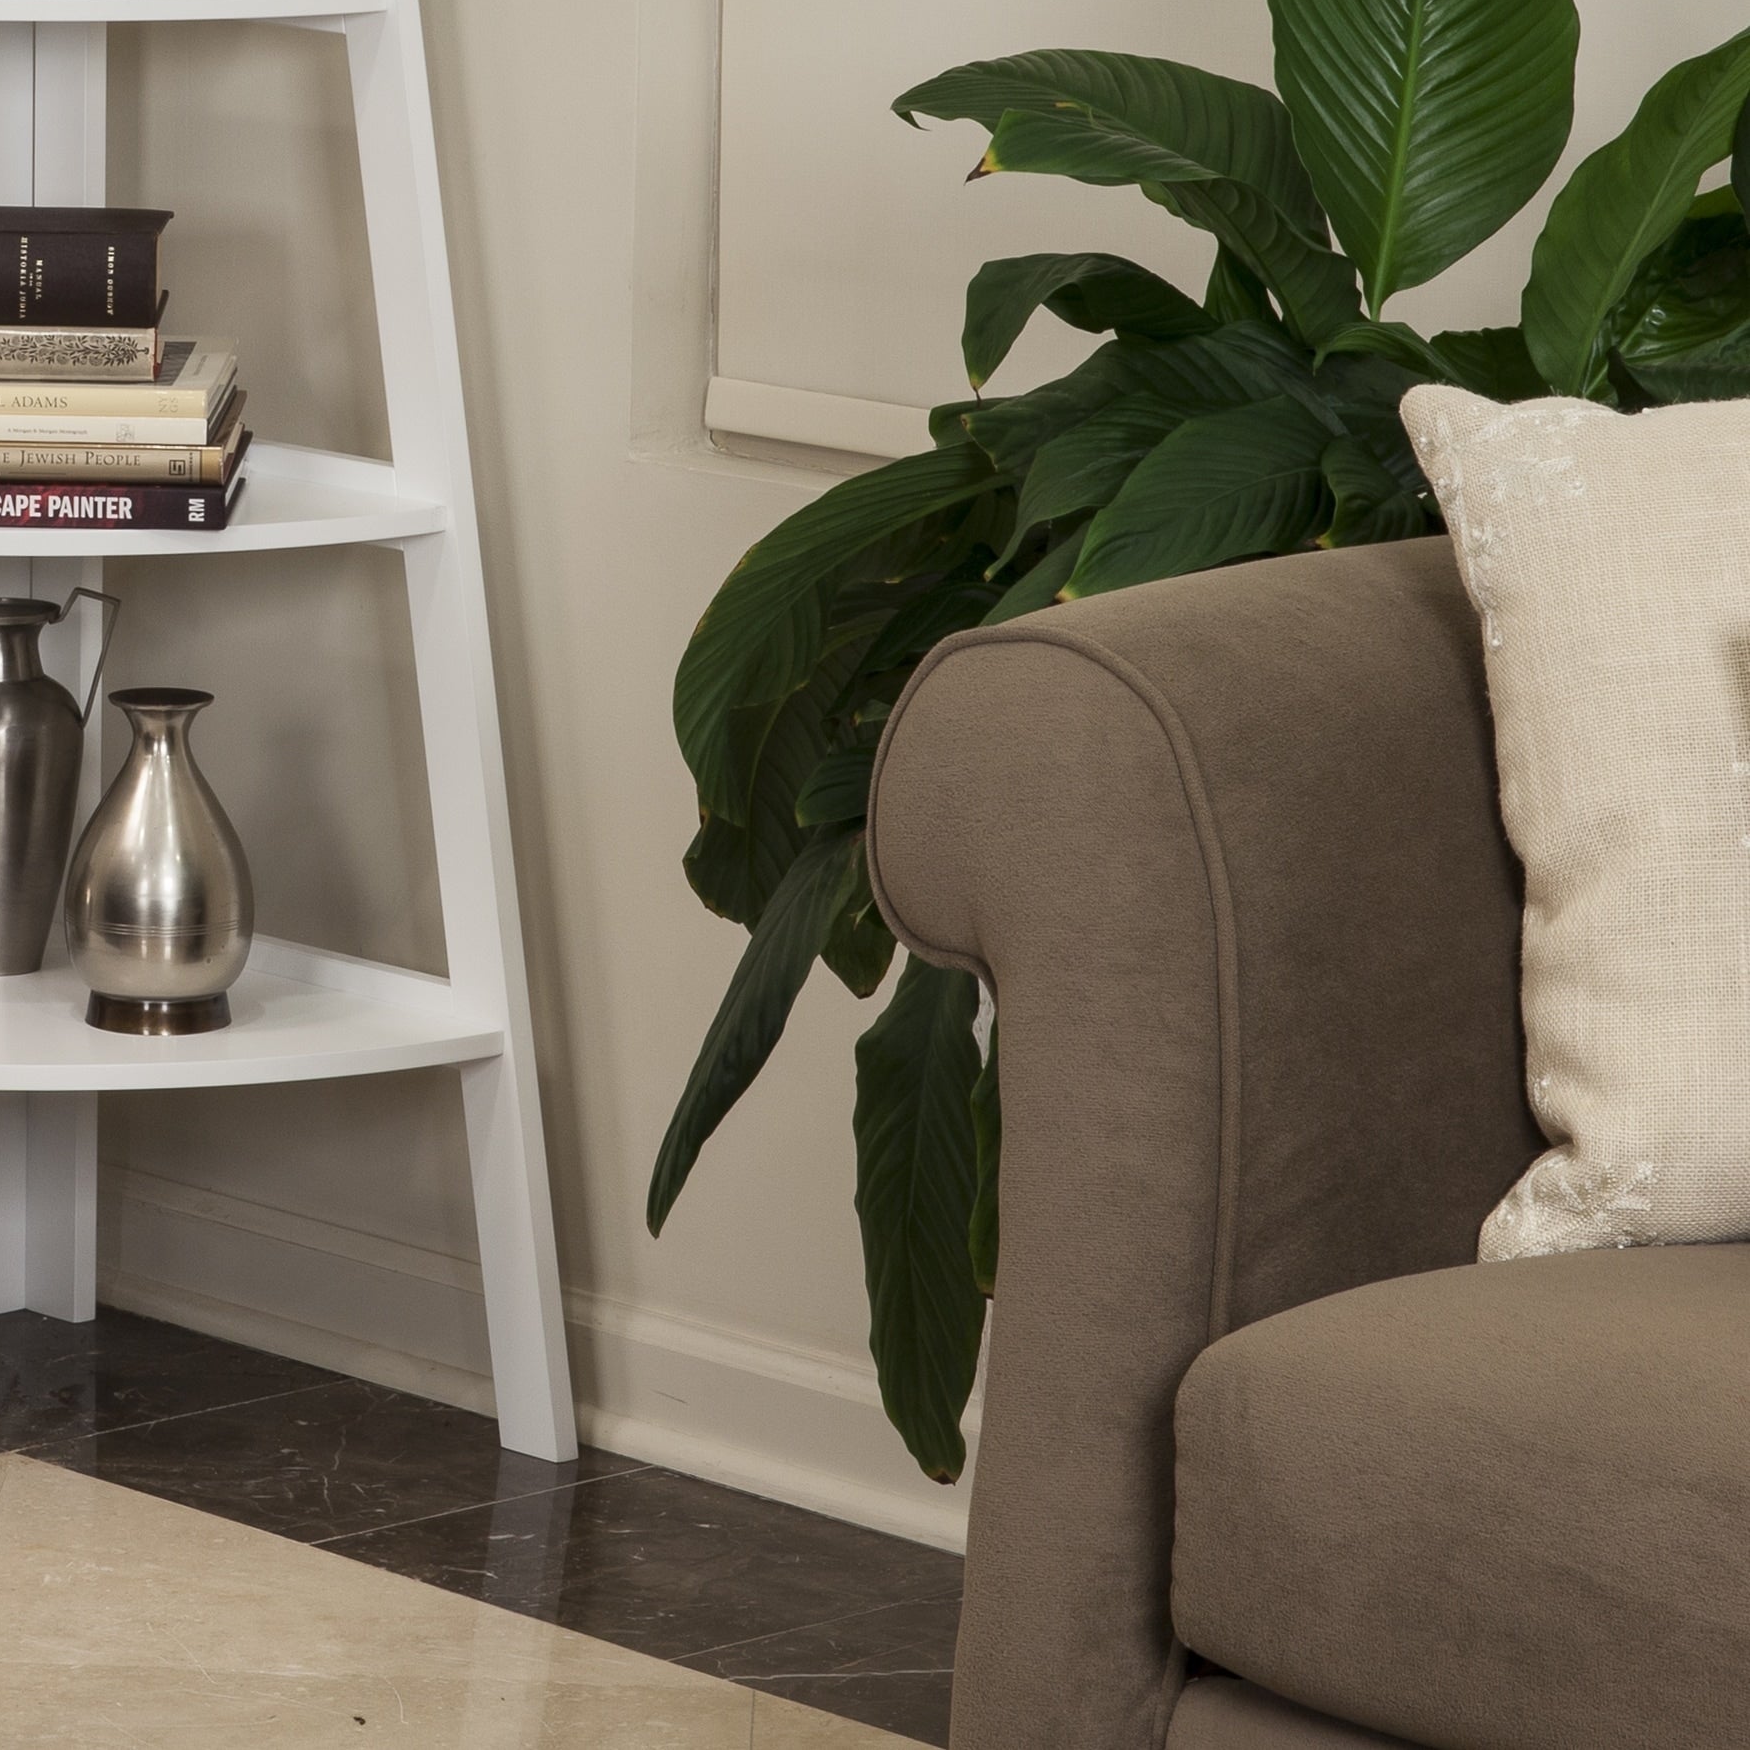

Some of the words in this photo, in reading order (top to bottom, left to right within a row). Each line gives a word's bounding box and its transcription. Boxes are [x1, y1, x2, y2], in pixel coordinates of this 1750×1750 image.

[20, 236, 28, 286] HISTORIA
[11, 396, 68, 409] ADAMS
[19, 450, 76, 467] JEWISH
[85, 451, 141, 467] PEOPLE
[48, 495, 133, 520] PAINTER
[188, 498, 205, 523] RM
